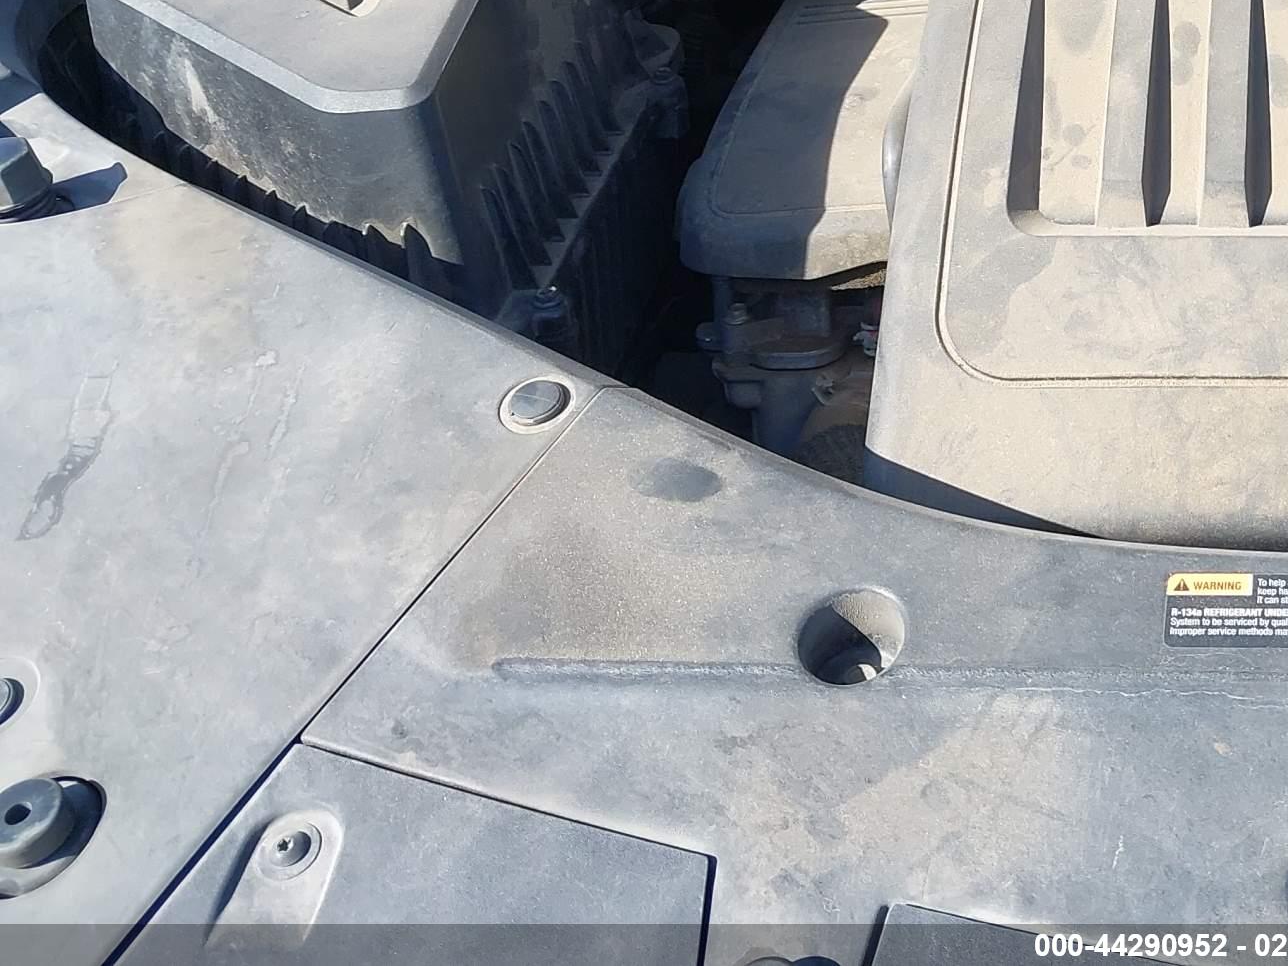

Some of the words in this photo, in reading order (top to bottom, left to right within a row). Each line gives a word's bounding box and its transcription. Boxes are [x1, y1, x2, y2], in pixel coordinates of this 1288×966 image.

[1193, 581, 1242, 591] WARNING
[1258, 578, 1266, 587] To
[1268, 578, 1286, 588] help
[1257, 587, 1277, 596] keep
[1257, 596, 1263, 604] It
[1264, 596, 1279, 604] can
[1171, 608, 1203, 617] R-134a
[1204, 608, 1263, 617] REFRIGERANT
[1170, 618, 1201, 627] System
[1202, 618, 1211, 627] to
[1212, 618, 1223, 627] be
[1224, 618, 1258, 627] serviced
[1260, 618, 1270, 627] by
[1170, 628, 1207, 637] Improper
[1208, 628, 1237, 637] service
[1239, 628, 1274, 637] methods
